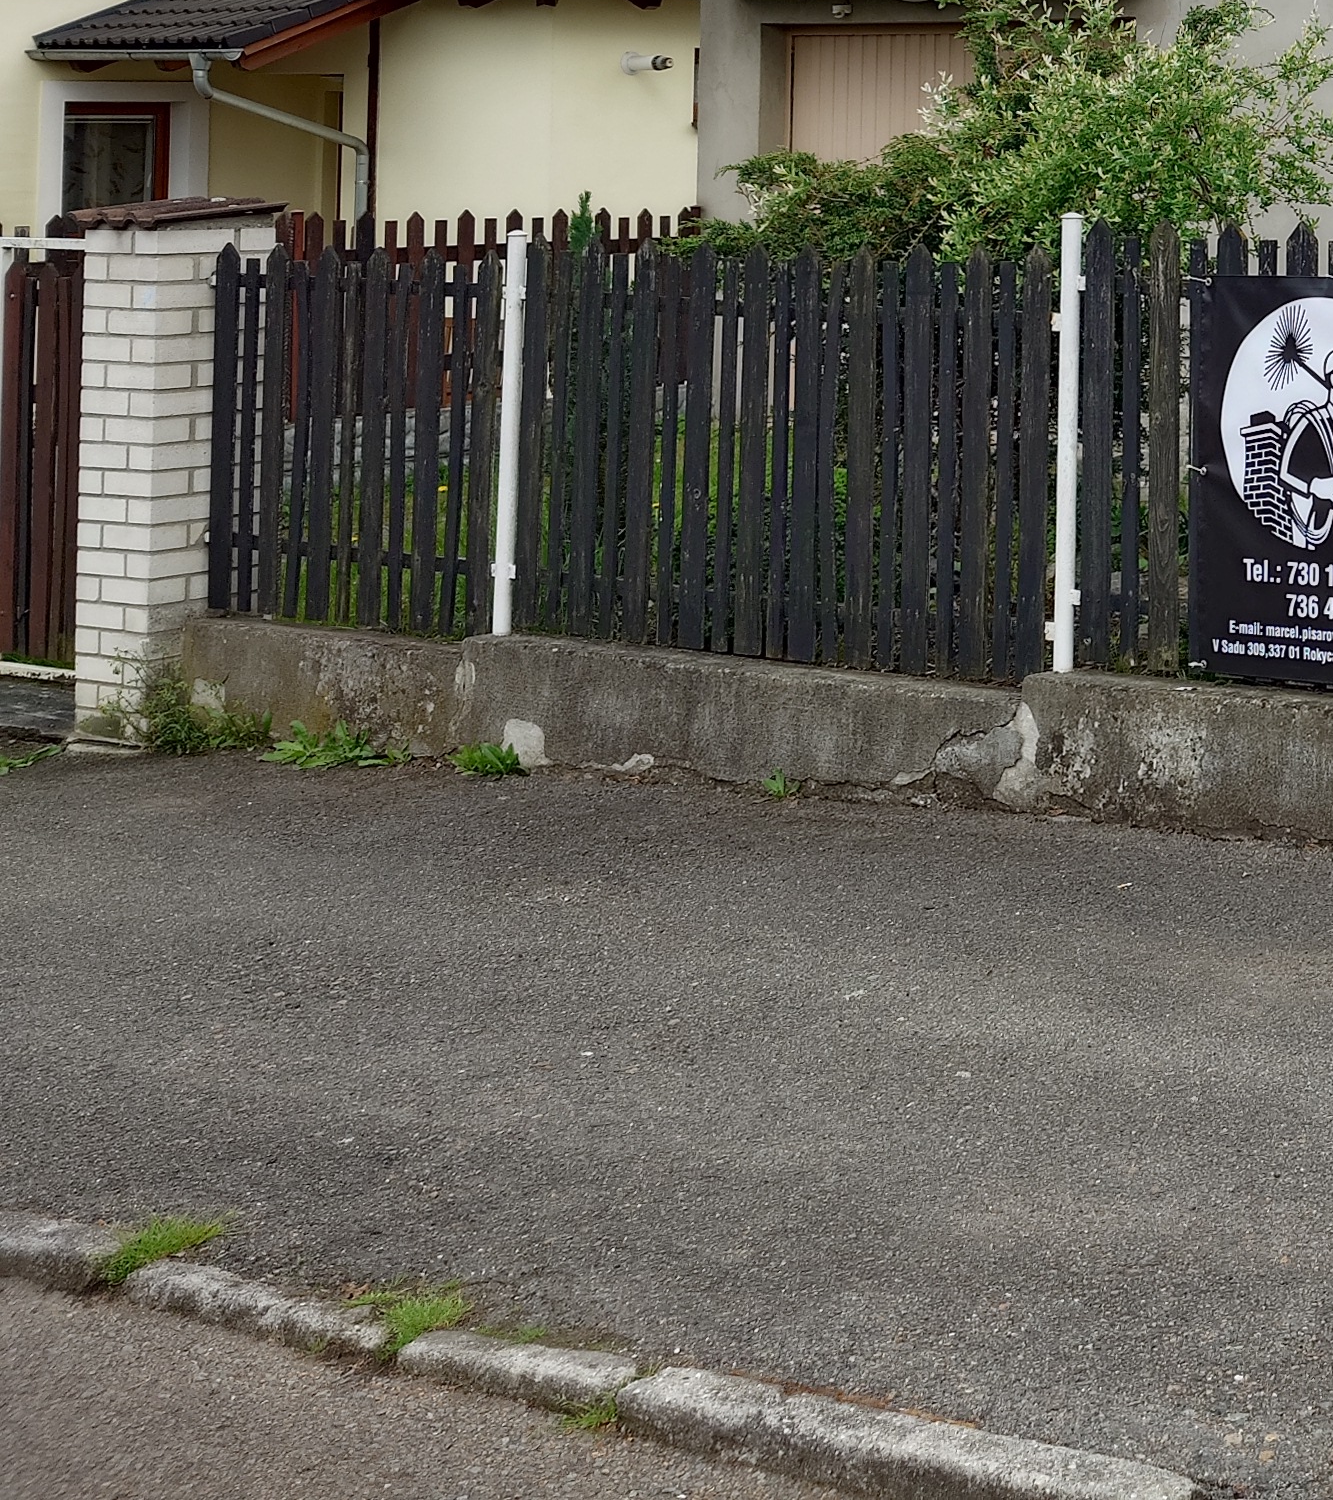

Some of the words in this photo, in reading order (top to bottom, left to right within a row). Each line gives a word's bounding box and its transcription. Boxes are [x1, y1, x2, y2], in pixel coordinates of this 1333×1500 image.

[1243, 558, 1282, 584] Tel.:
[1287, 561, 1320, 586] 730
[1286, 593, 1319, 619] 736
[1229, 620, 1263, 636] E-mail:
[1212, 638, 1220, 652] V
[1221, 640, 1245, 655] Sadu
[1247, 642, 1286, 660] 309,337
[1288, 646, 1300, 660] 01
